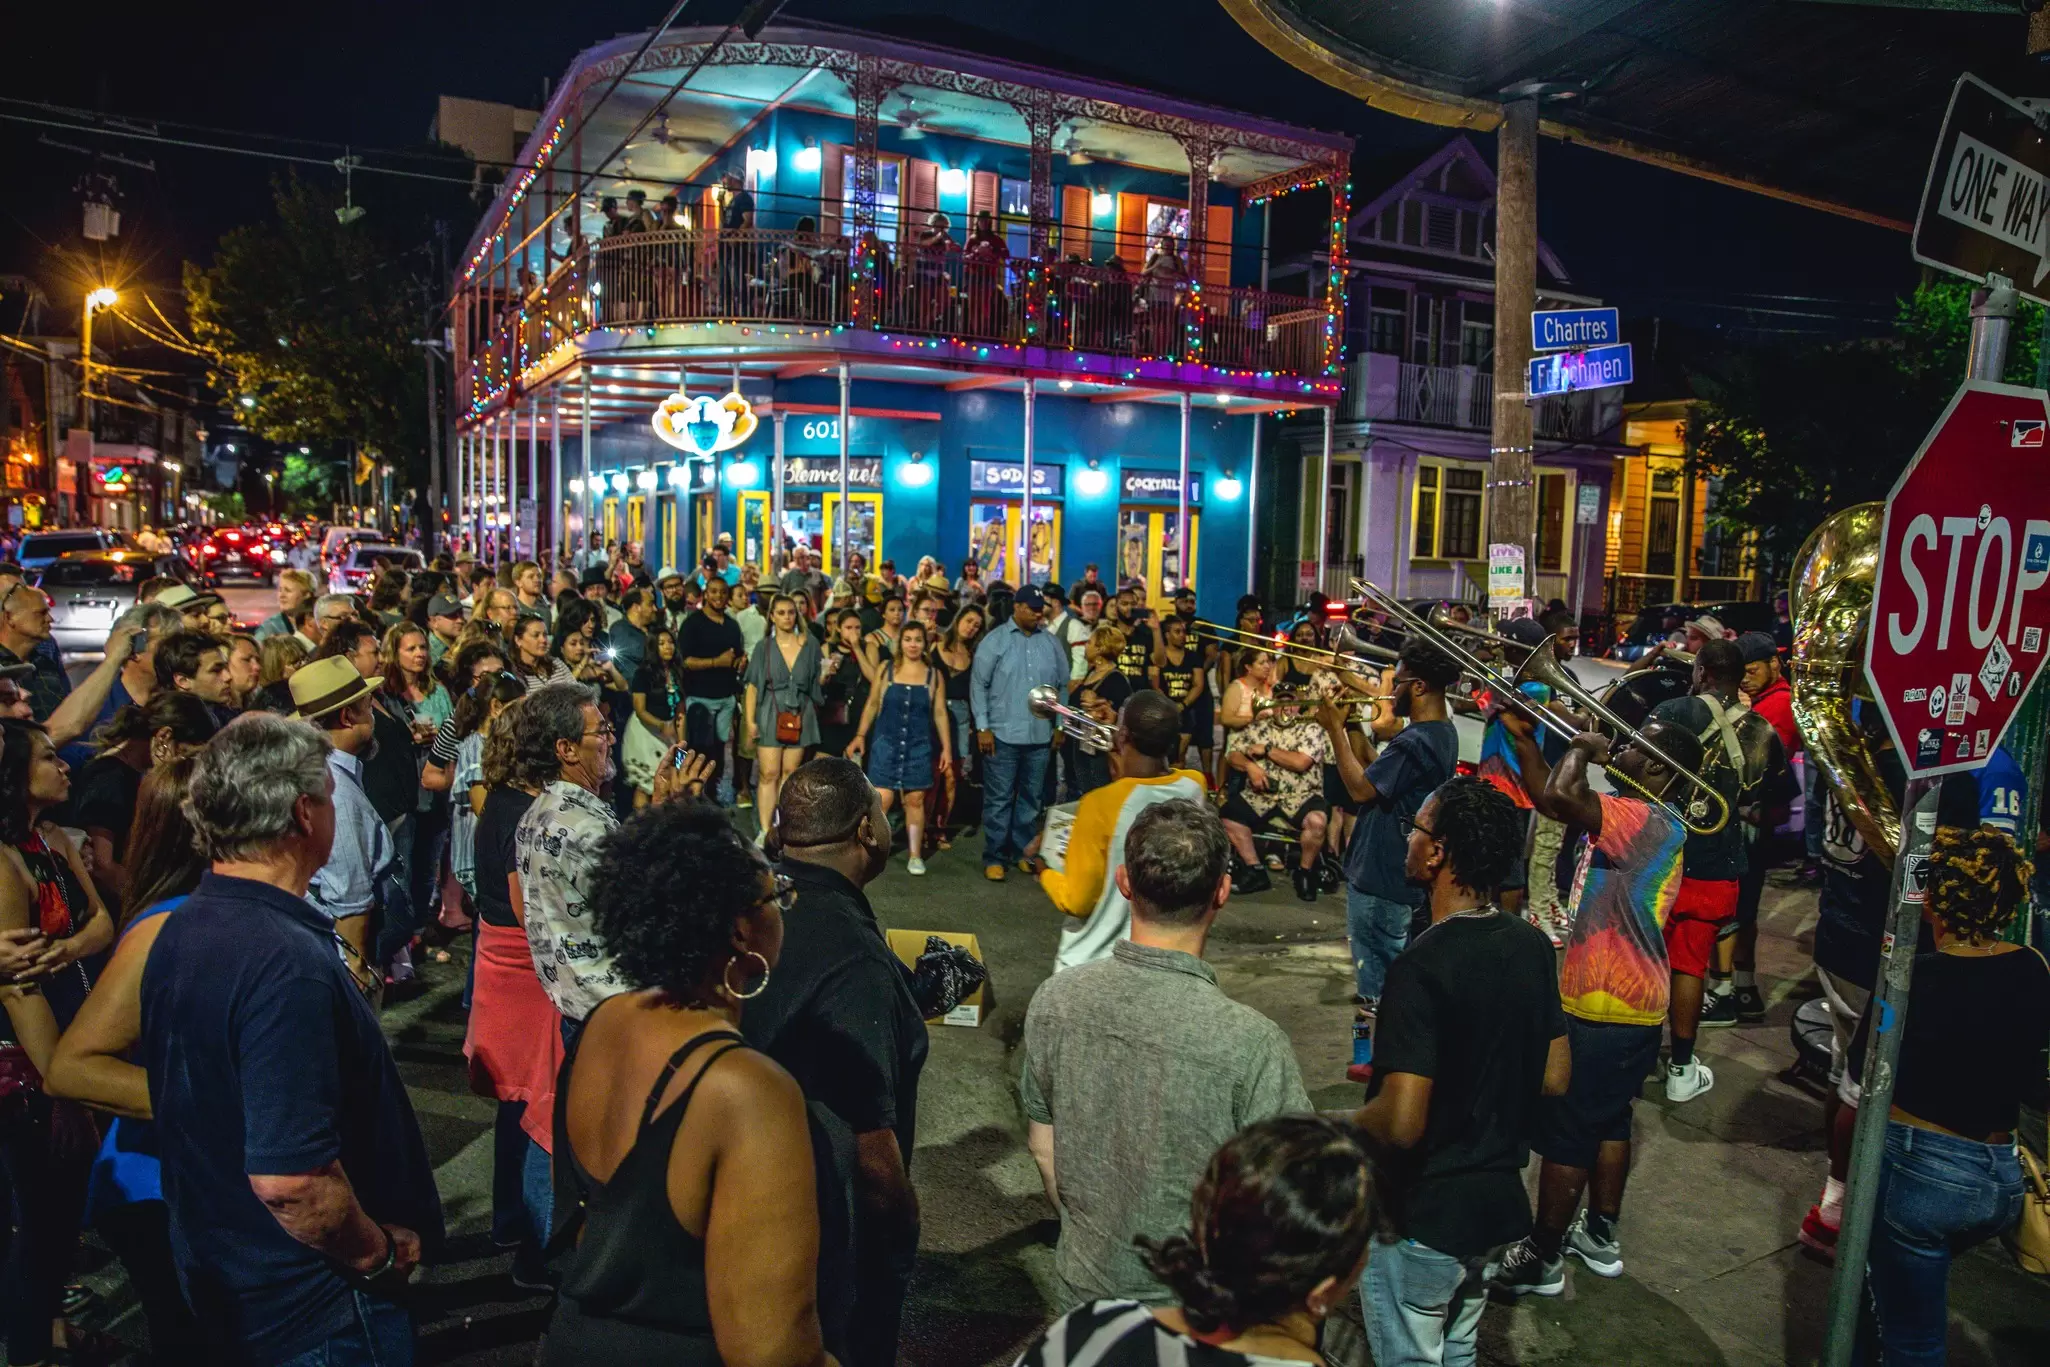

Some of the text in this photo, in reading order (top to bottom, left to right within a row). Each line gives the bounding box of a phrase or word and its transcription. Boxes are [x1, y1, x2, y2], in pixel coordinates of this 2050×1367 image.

[1950, 147, 2050, 245] ONE WAY
[1544, 316, 1609, 343] Chartres
[803, 420, 840, 440] 601
[985, 466, 1046, 485] SODS
[1888, 513, 2050, 656] STOP
[1992, 787, 2020, 817] 16
